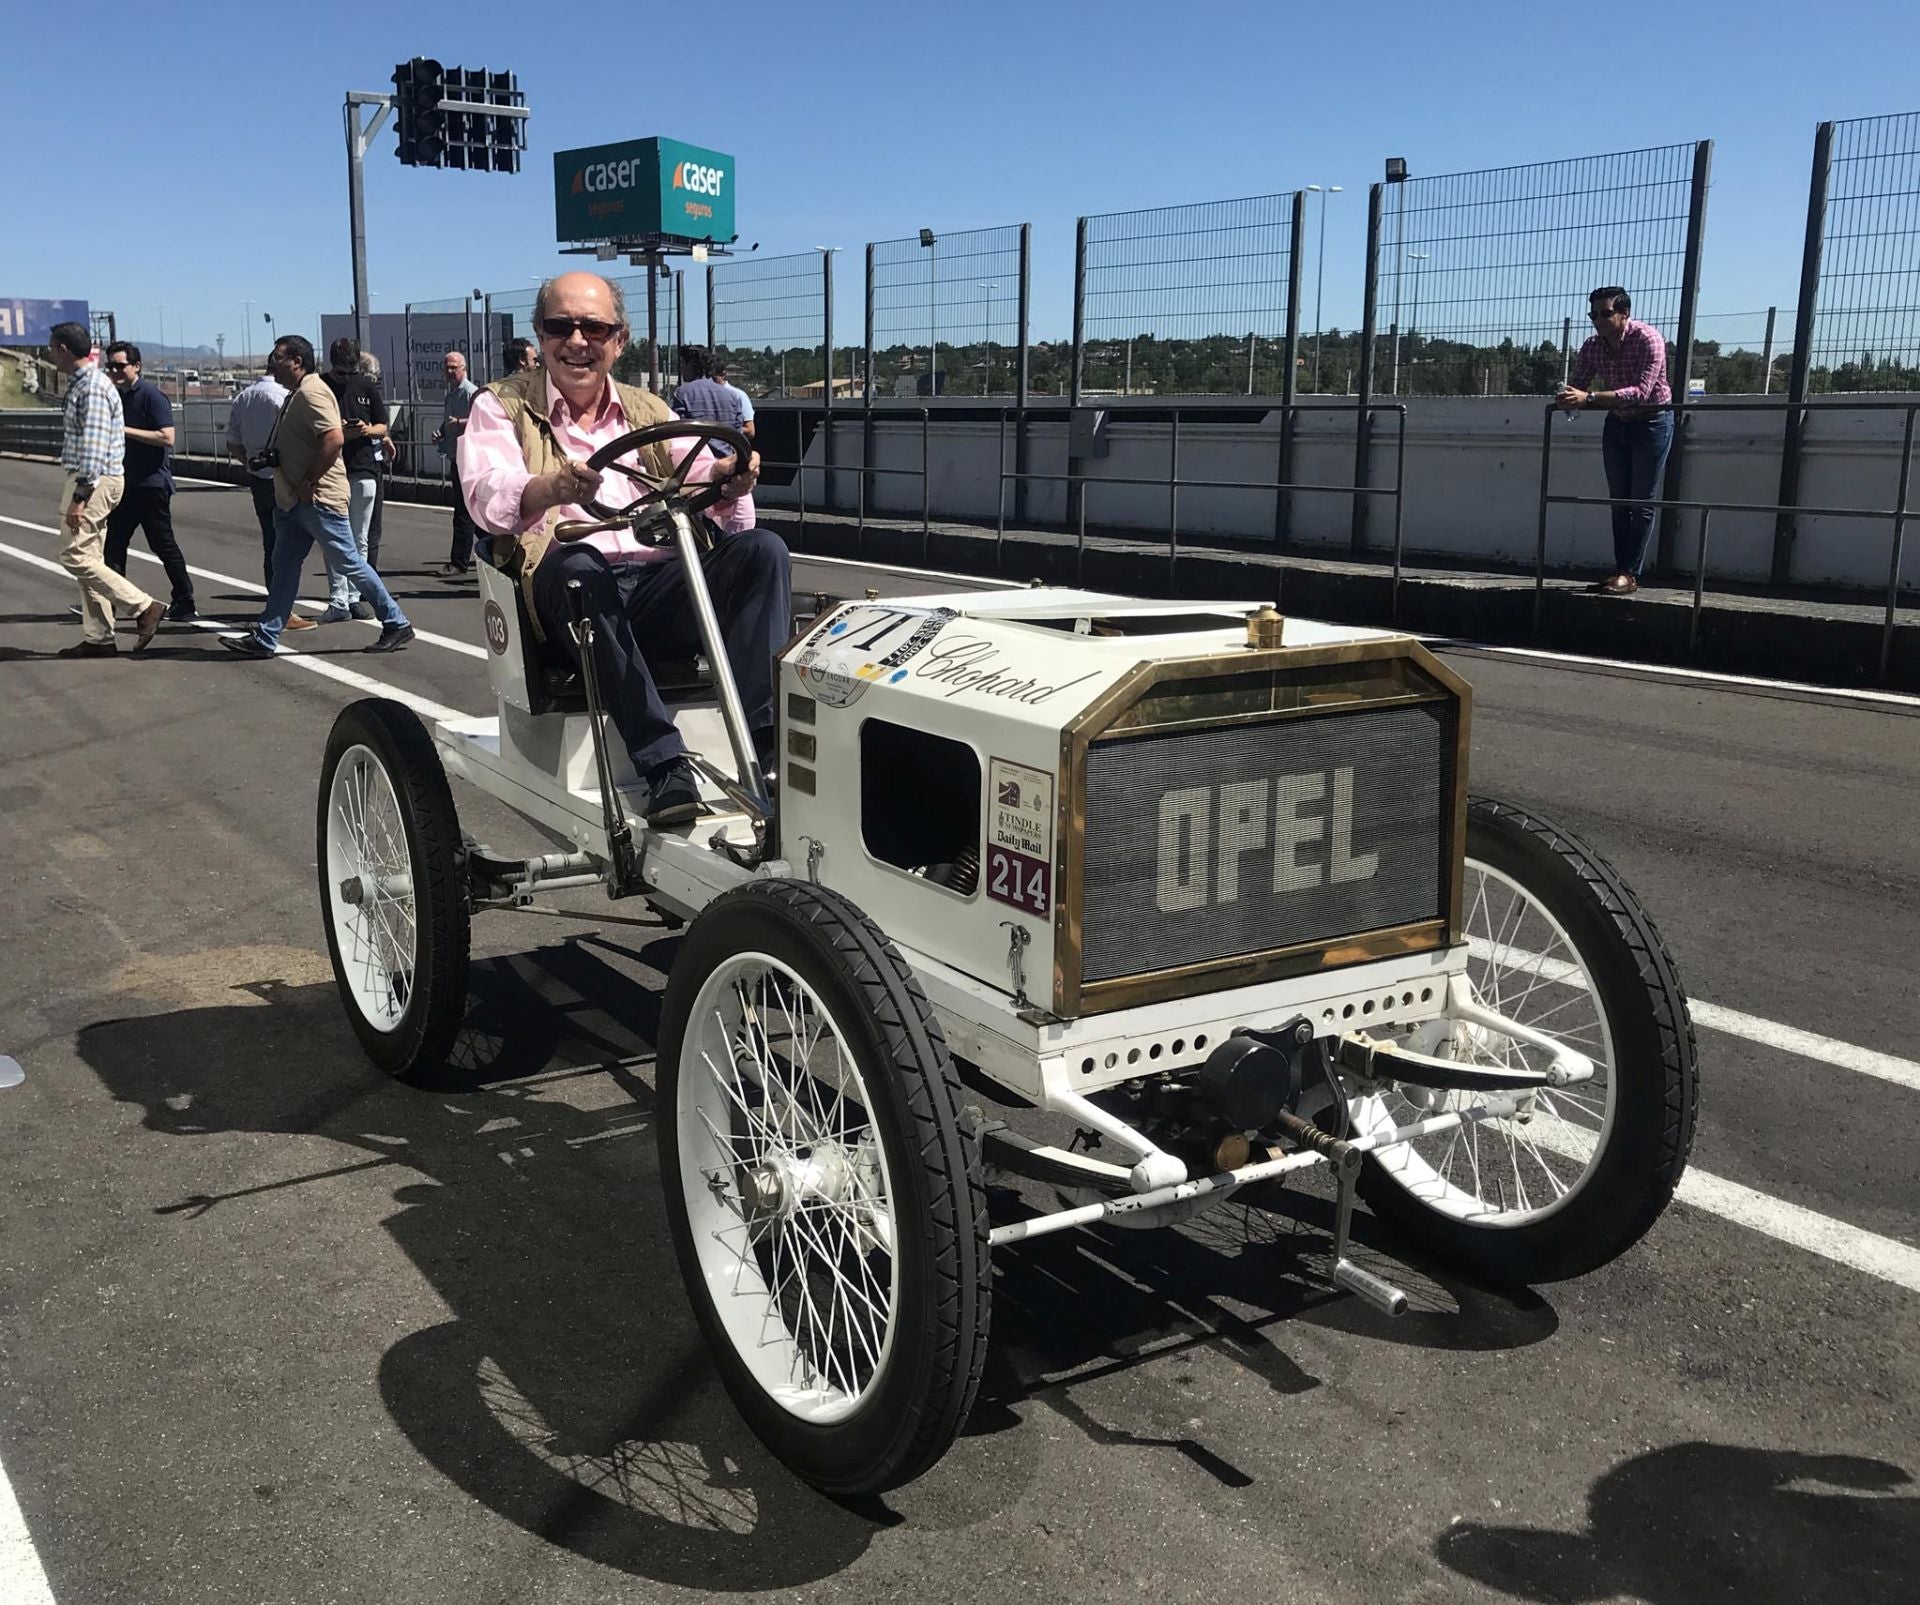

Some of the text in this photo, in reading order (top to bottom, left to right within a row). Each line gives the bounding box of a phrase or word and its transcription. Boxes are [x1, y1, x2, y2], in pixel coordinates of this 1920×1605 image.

[584, 158, 640, 192] caser
[683, 161, 724, 197] caser
[684, 201, 713, 220] seguros
[444, 339, 455, 353] al
[458, 339, 488, 353] Cub
[487, 614, 505, 644] 103
[916, 635, 1102, 705] Chopard
[1004, 812, 1042, 833] TINDLE
[997, 830, 1042, 855] Daily Mail
[1156, 766, 1379, 913] OPEL
[992, 853, 1046, 911] 214
